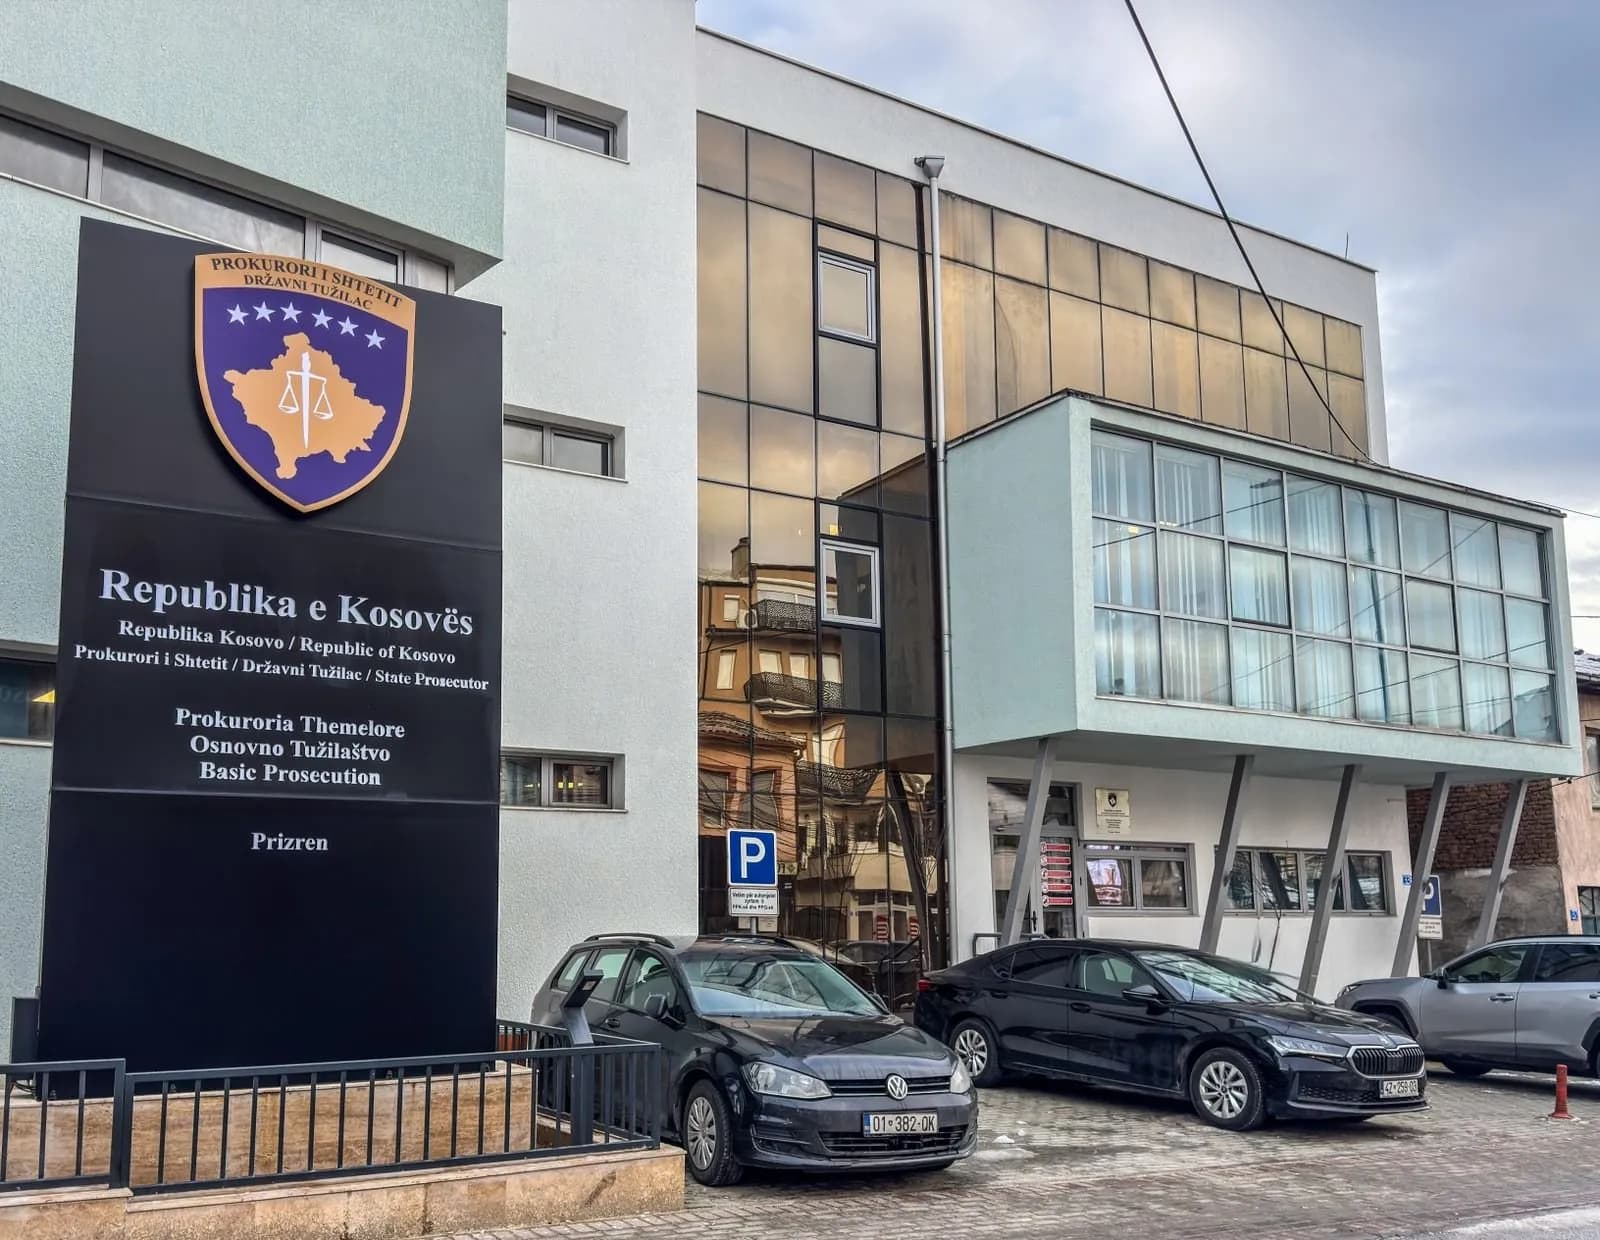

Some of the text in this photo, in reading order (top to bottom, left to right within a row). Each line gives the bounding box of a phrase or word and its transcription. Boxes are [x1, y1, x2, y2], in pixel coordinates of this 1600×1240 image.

[211, 258, 402, 308] PROKURORI I SHTETIT
[244, 273, 374, 310] DRŽAVNI TUŽILAC
[99, 569, 472, 635] Republika e Kosovës
[119, 620, 455, 663] Republika Kosovo / Republic of Kosovo
[74, 645, 489, 690] Prokurori i Shtetit / Državni Tužilac / State Prosecutor
[176, 708, 405, 737] Prokuroria Themelore
[191, 735, 390, 761] Osnovno Tužilaštvo
[200, 762, 381, 785] Basic Prosecution
[252, 833, 327, 850] Prizren
[741, 837, 766, 878] P
[1422, 882, 1434, 911] P
